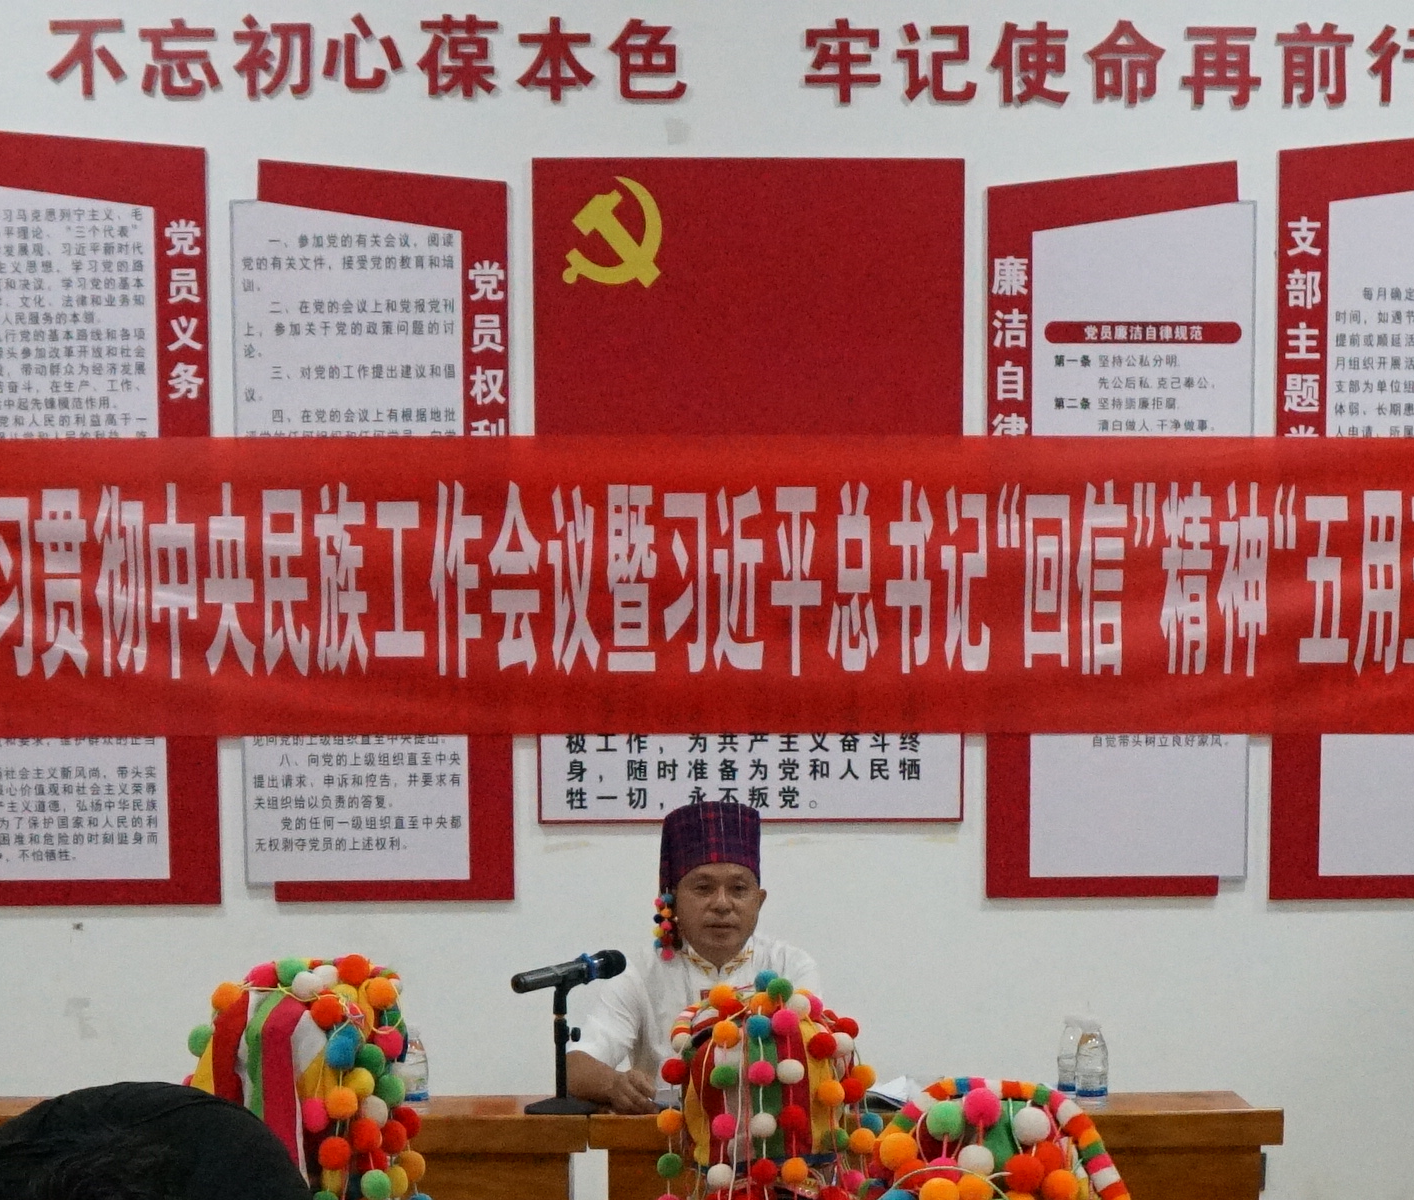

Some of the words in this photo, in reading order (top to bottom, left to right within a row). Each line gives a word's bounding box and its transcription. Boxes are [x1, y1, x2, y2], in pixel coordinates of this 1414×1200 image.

[47, 14, 689, 102] 不忘初心葆本色
[164, 218, 205, 400] 党员义务
[1084, 325, 1203, 341] 党员廉洁自律规范
[1283, 216, 1322, 437] 支部主题
[1054, 355, 1091, 367] 第一条
[1054, 398, 1091, 410] 第二条
[565, 759, 922, 782] 身，随时准备为党和人民牺
[281, 816, 462, 830] 党的任何一级组织直至中央都
